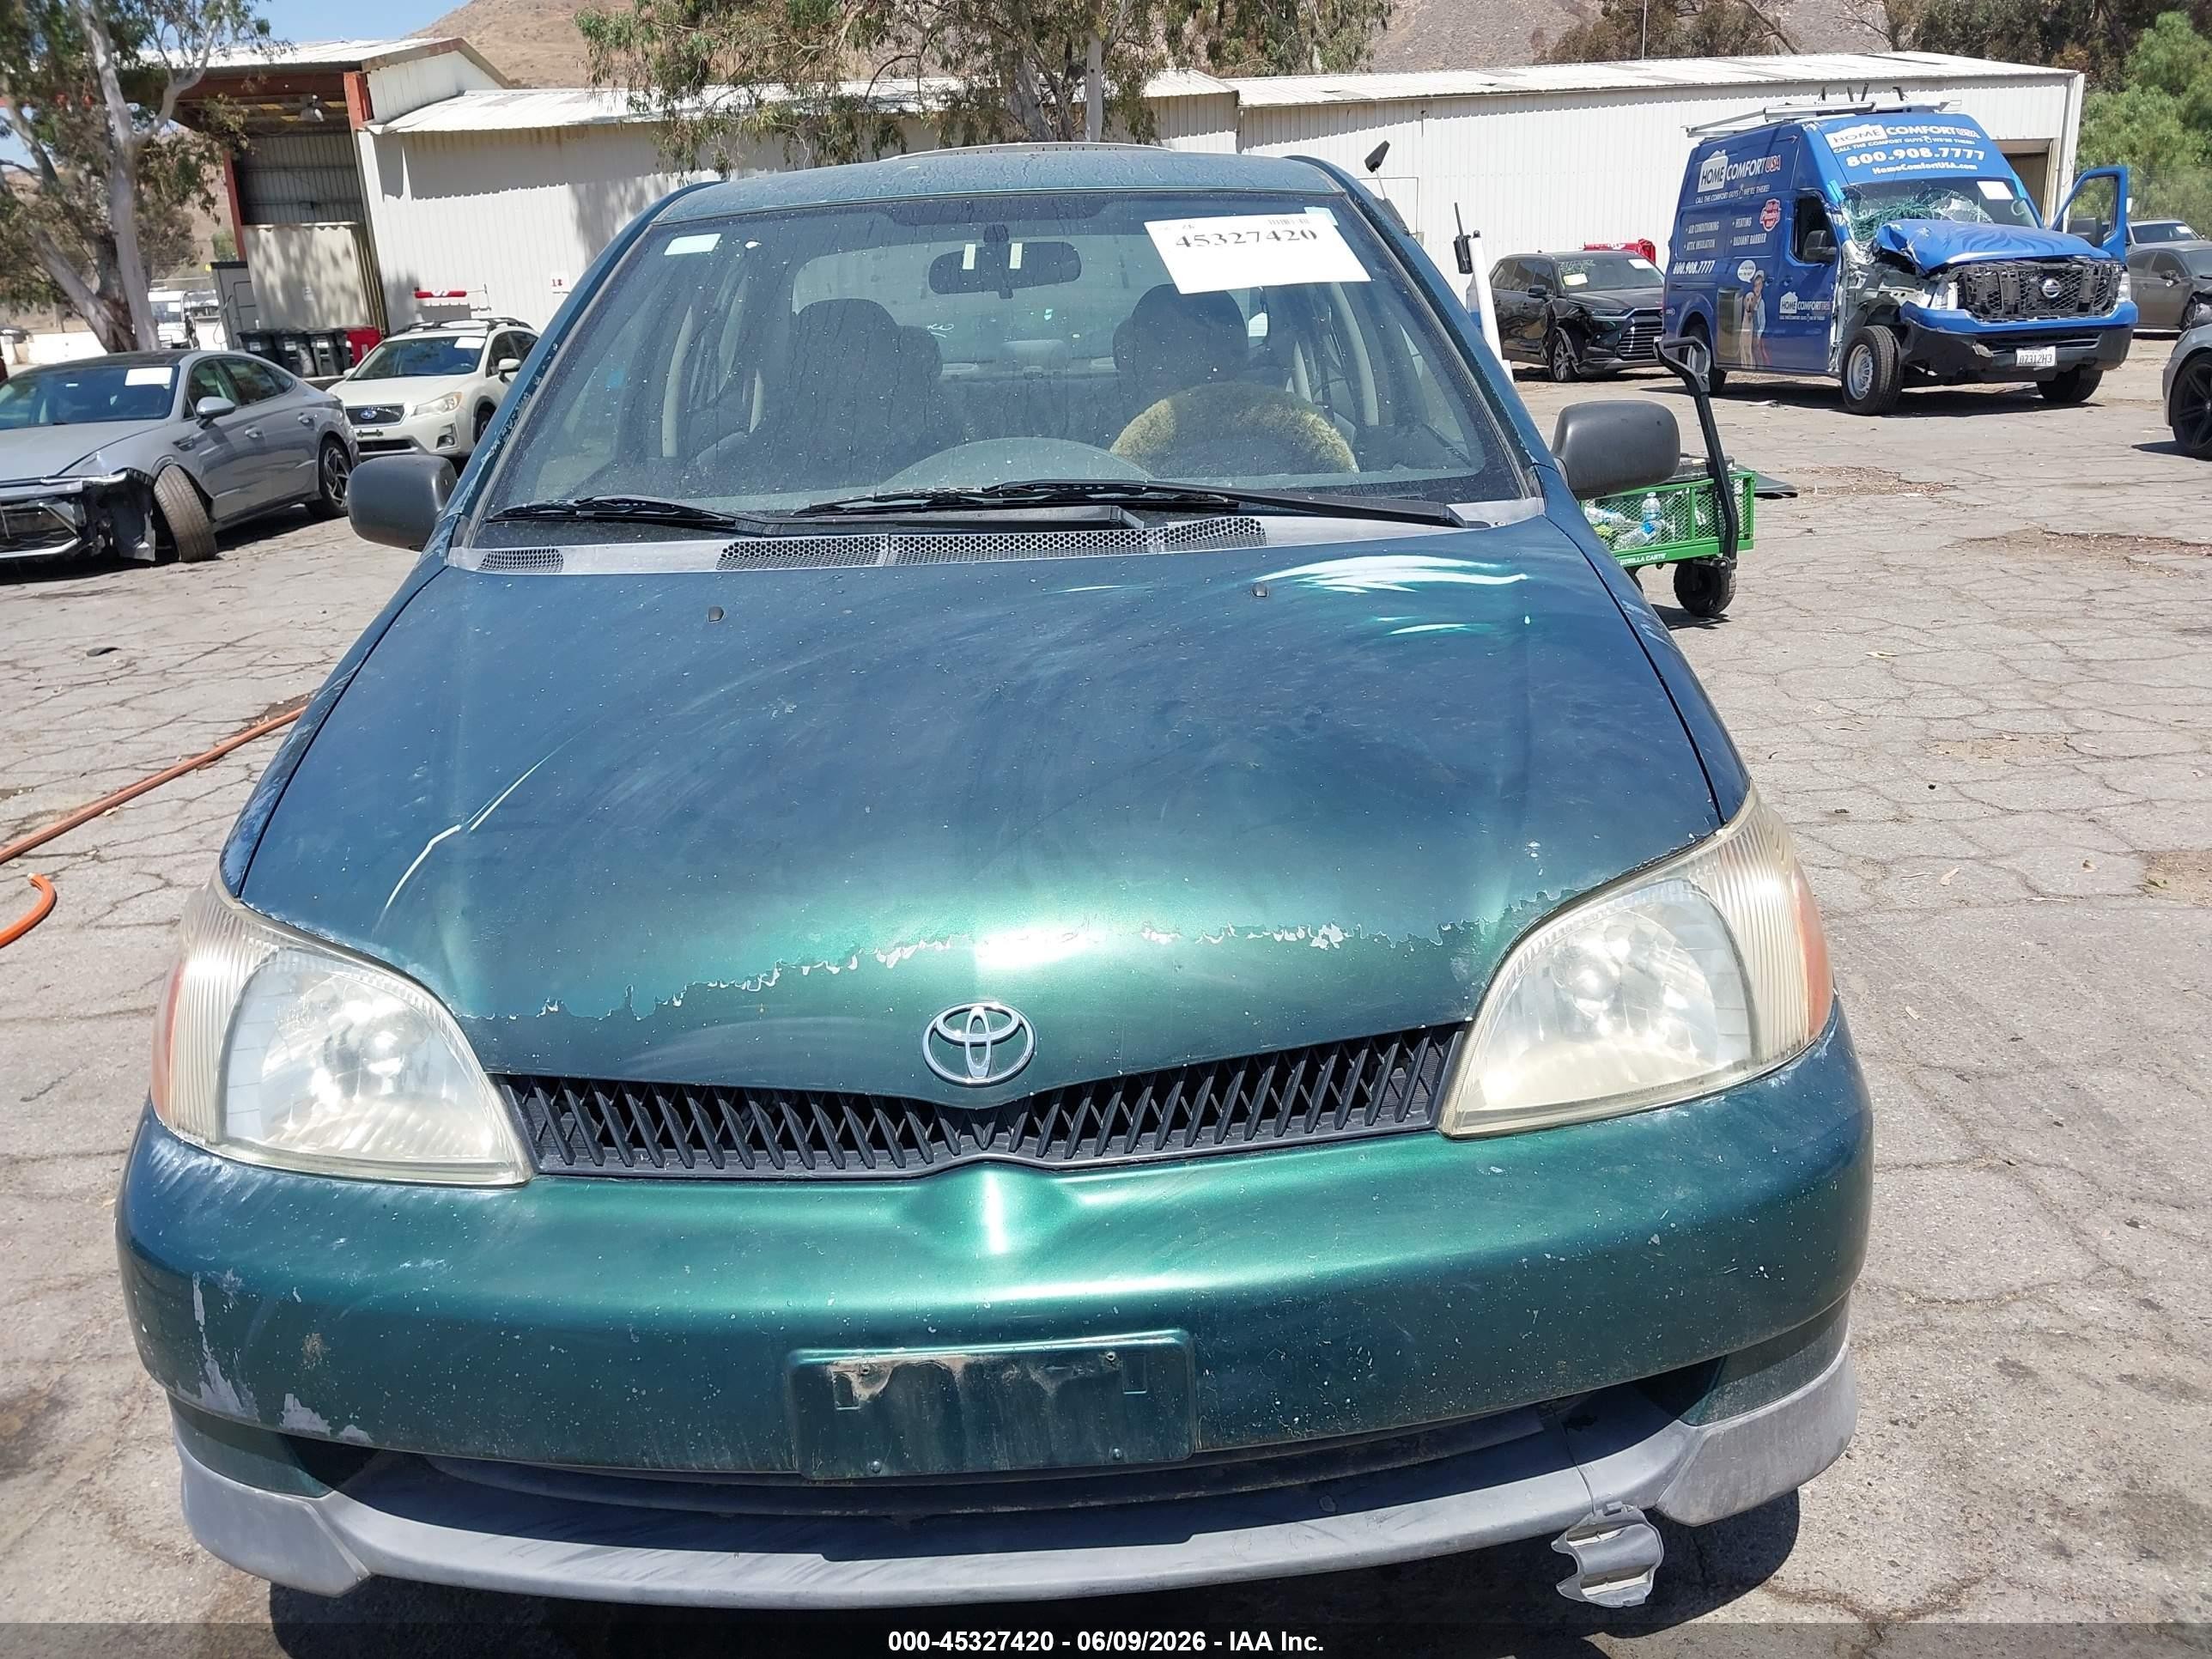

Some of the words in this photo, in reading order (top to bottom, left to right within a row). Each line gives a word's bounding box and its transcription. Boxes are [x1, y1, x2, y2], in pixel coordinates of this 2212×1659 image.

[1833, 131, 1881, 143] HOME
[1869, 138, 1903, 147] COMFORT
[1846, 147, 1985, 167] 800.908.7777
[1872, 161, 1978, 174] HomeComfortUSA.com
[1701, 166, 1725, 185] HOME
[1695, 196, 1704, 204] CALL
[1711, 191, 1729, 202] COMFORT
[1729, 189, 1739, 198] GUYS
[1694, 221, 1720, 234] CONDITIONING
[1735, 216, 1753, 228] HEATING
[1176, 228, 1317, 247] 45327420
[1673, 259, 1717, 275] 800.908.7777
[1781, 301, 1797, 310] HOME
[1618, 556, 1645, 565] ORILLA
